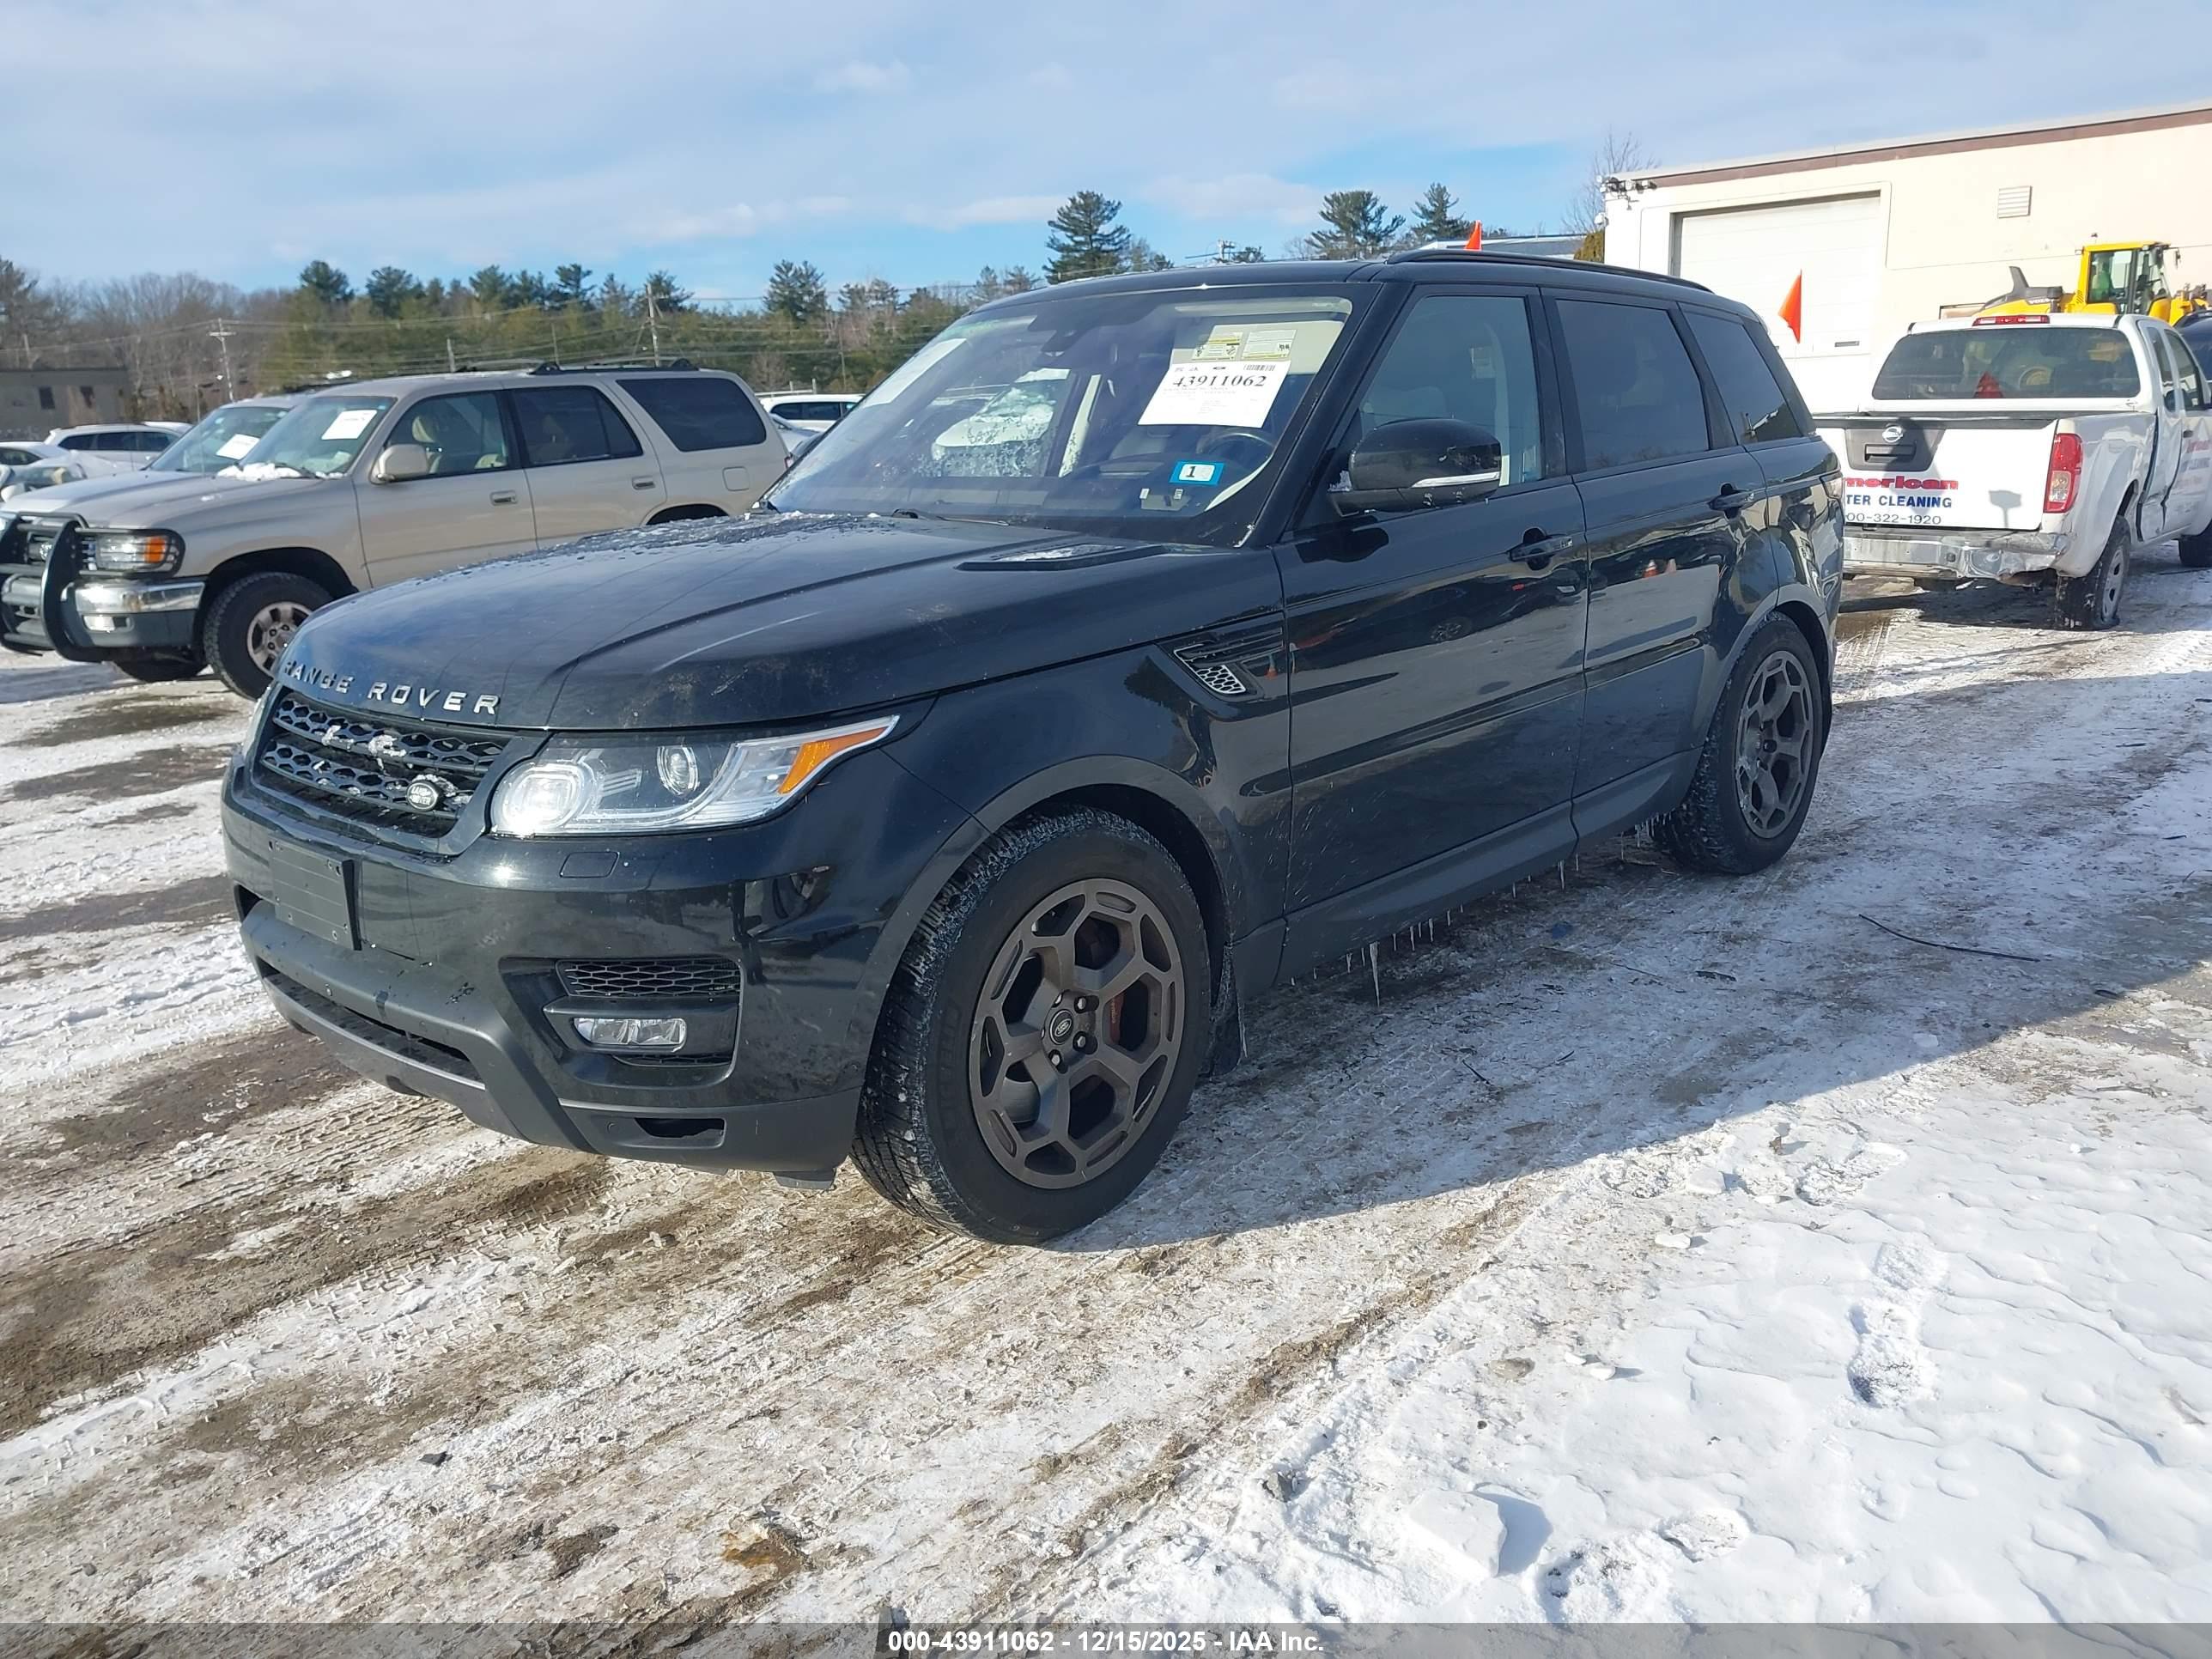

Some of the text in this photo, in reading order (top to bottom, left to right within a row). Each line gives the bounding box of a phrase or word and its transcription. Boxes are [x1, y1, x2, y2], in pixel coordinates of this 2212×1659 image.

[1173, 375, 1267, 387] 43911062
[1186, 466, 1196, 477] 1
[1879, 495, 1952, 507] CLEANING
[1845, 512, 1942, 525] 00-322-1920
[368, 682, 500, 714] ROVER
